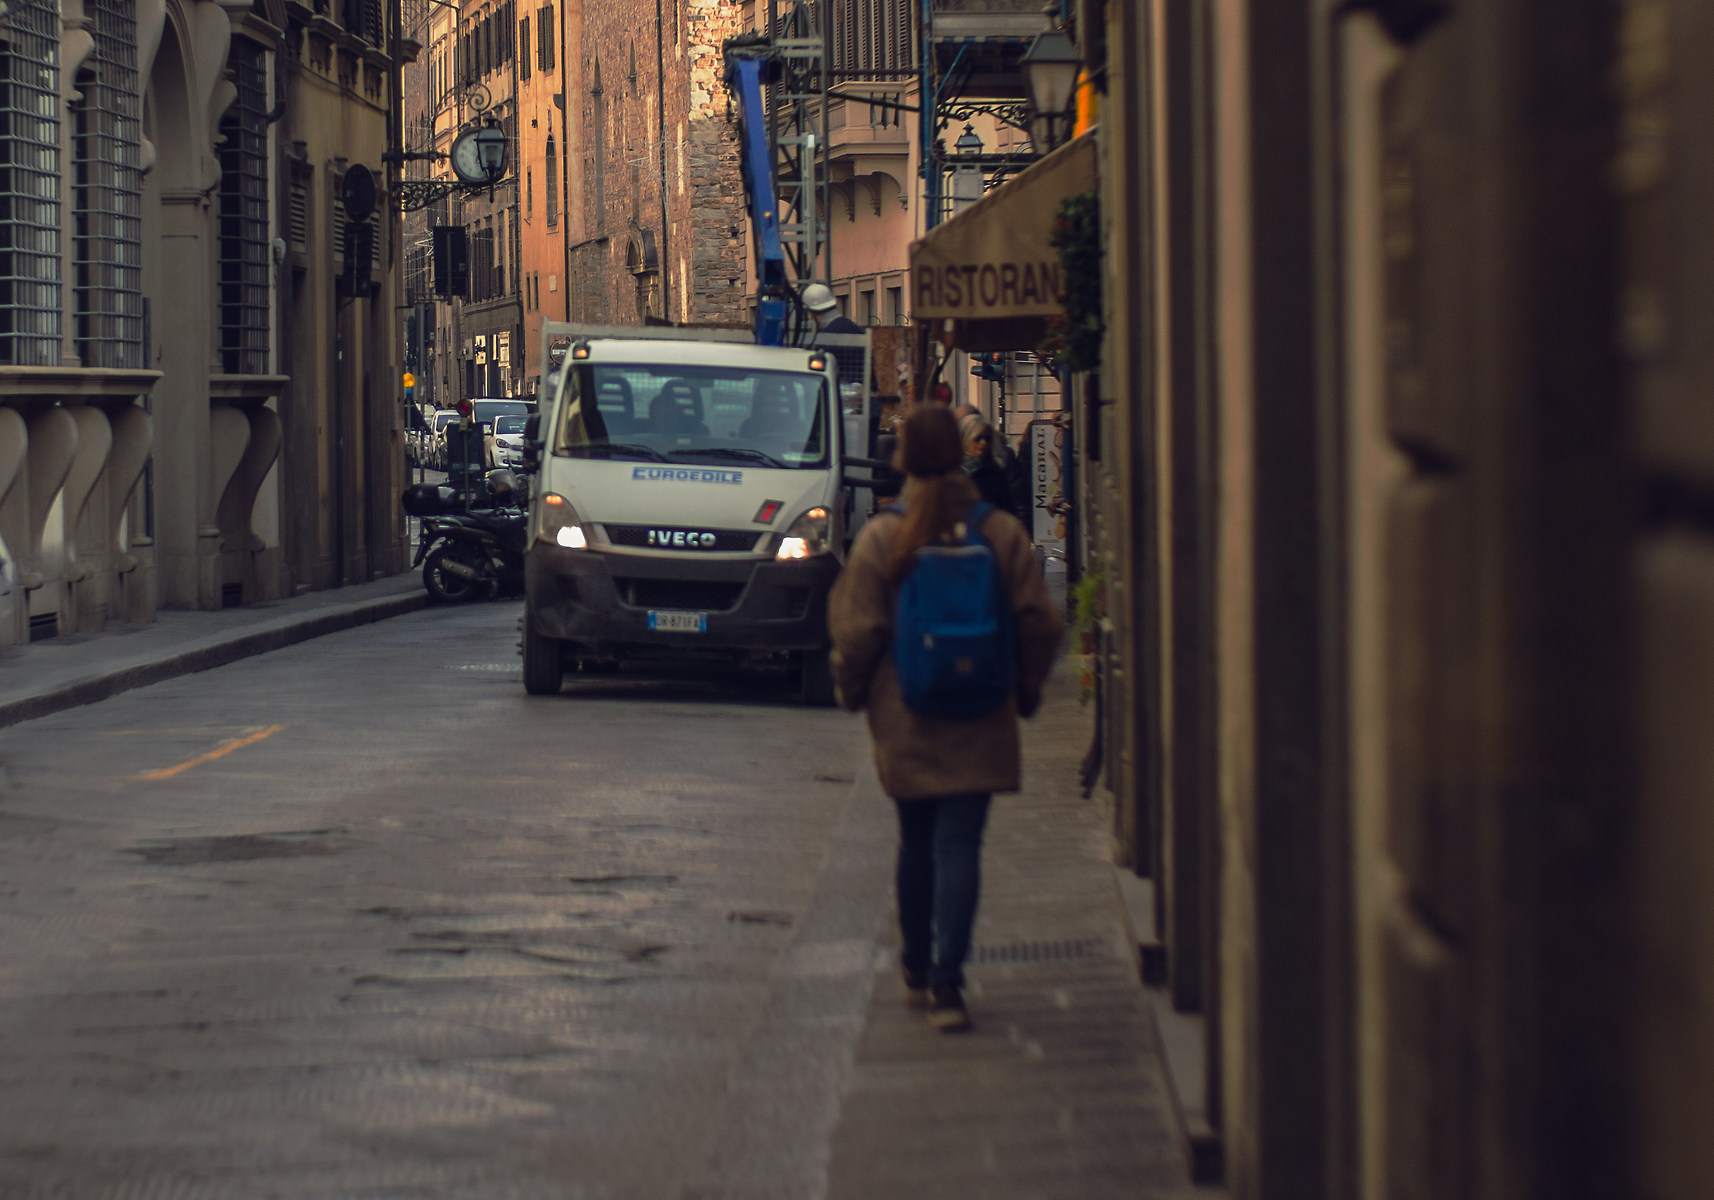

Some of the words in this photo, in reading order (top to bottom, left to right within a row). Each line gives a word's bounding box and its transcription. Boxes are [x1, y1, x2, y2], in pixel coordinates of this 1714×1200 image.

[916, 262, 1065, 308] RISTORAN
[631, 466, 743, 485] EUROEDILE
[648, 529, 717, 547] IVECO
